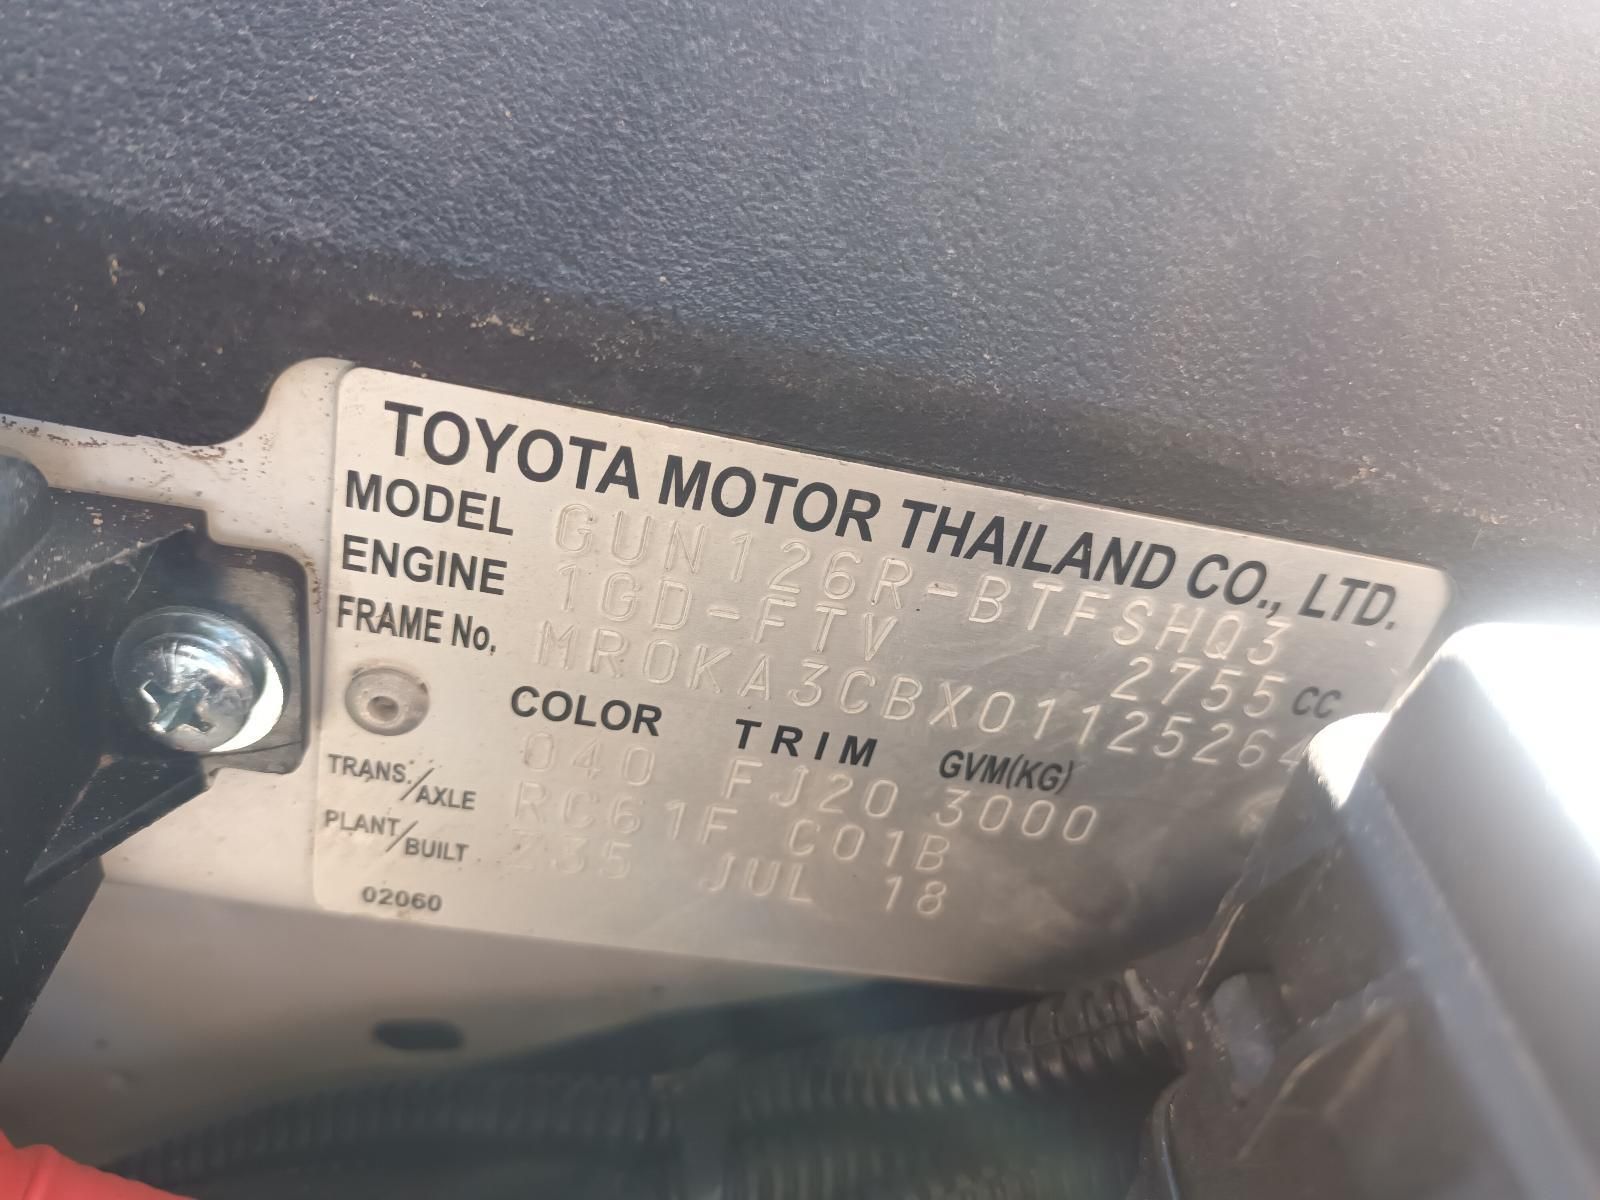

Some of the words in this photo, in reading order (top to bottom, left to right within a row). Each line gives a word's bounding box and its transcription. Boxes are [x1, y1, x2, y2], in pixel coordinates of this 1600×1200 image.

[384, 400, 641, 500] TOYOTA
[658, 454, 882, 542] MOTOR
[901, 500, 1176, 590] THAILAND
[1298, 572, 1399, 630] LTD.
[345, 470, 514, 536] MODEL
[555, 503, 1293, 666] GUN126R-BTFSHQ3
[336, 594, 445, 644] FRAME
[342, 534, 508, 596] ENGINE
[558, 562, 898, 662] 1GD-FTV
[1110, 655, 1291, 720] 2755
[510, 685, 663, 737] COLOR
[735, 718, 878, 768] TRIM
[938, 749, 1074, 795] GVM(KG)
[721, 759, 898, 819] FJ20
[934, 788, 1097, 843] 3000
[361, 886, 443, 912] 02060
[706, 852, 813, 903] JUL
[885, 875, 947, 915] 18
